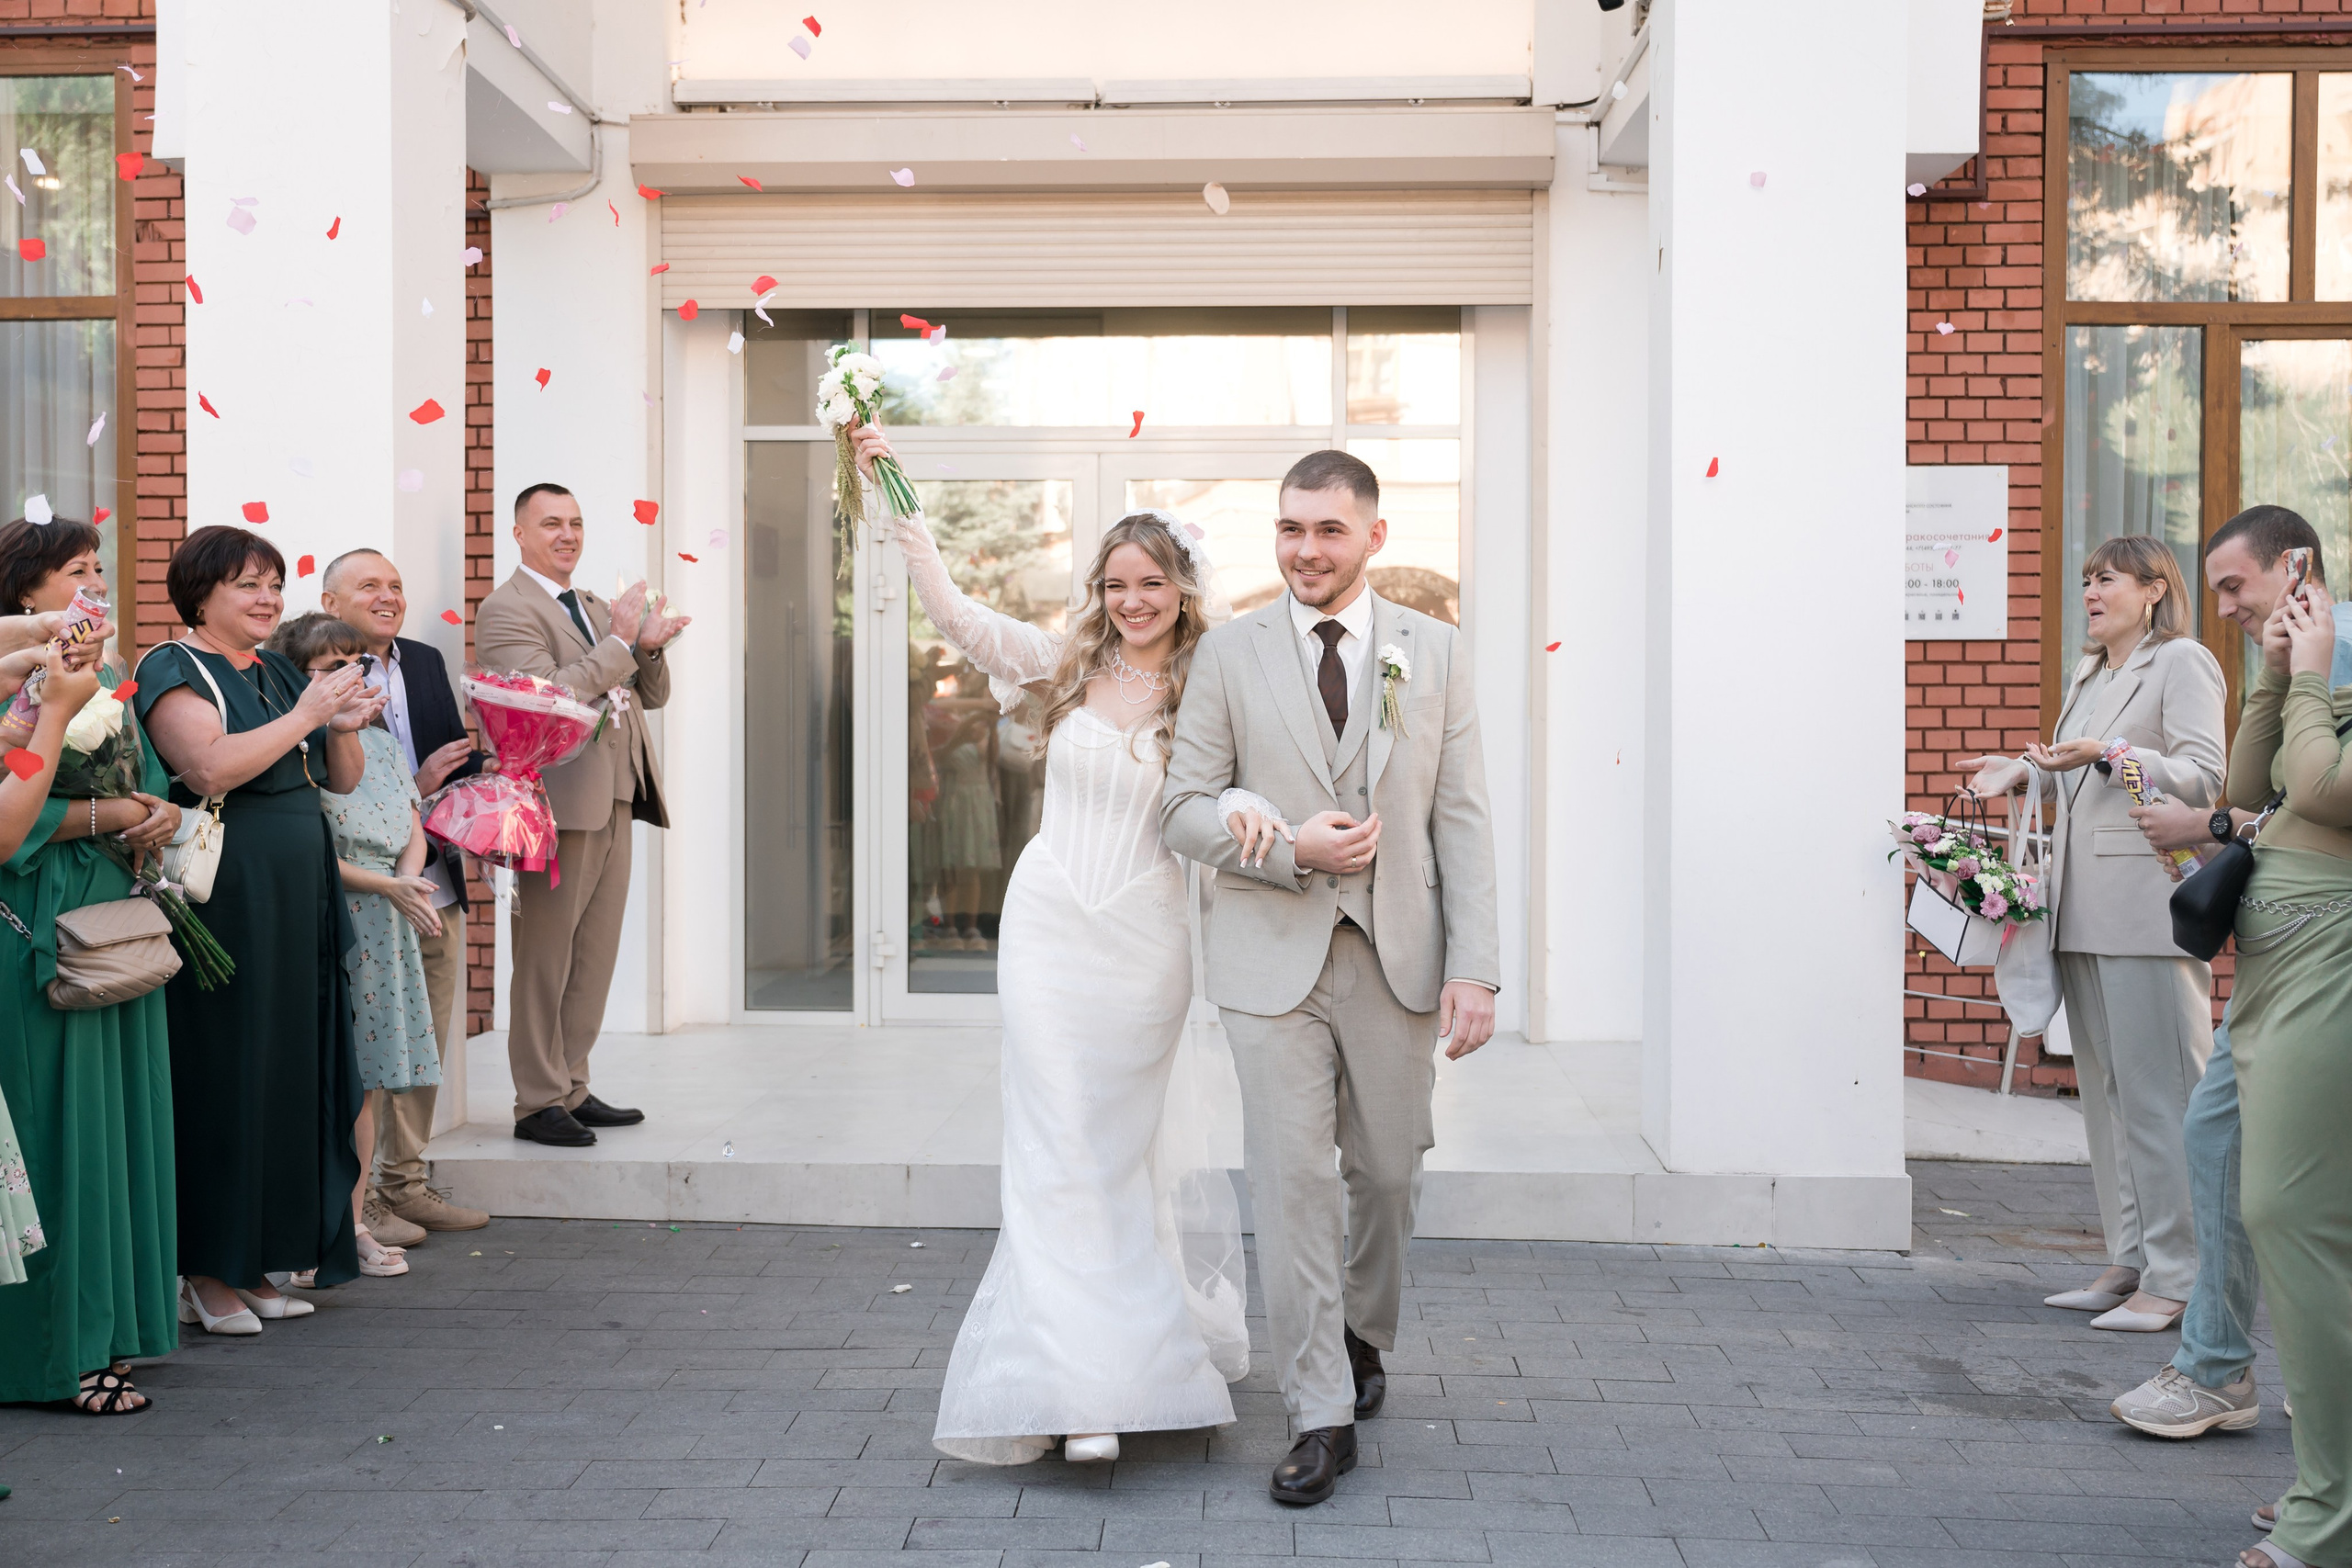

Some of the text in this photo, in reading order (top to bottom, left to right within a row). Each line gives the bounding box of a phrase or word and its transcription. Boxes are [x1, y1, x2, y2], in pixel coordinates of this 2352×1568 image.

[1905, 534, 1990, 544] ракосочетания
[1905, 562, 1934, 572] БОТЫ
[1905, 579, 1921, 589] :00
[1931, 579, 1960, 589] 18:00
